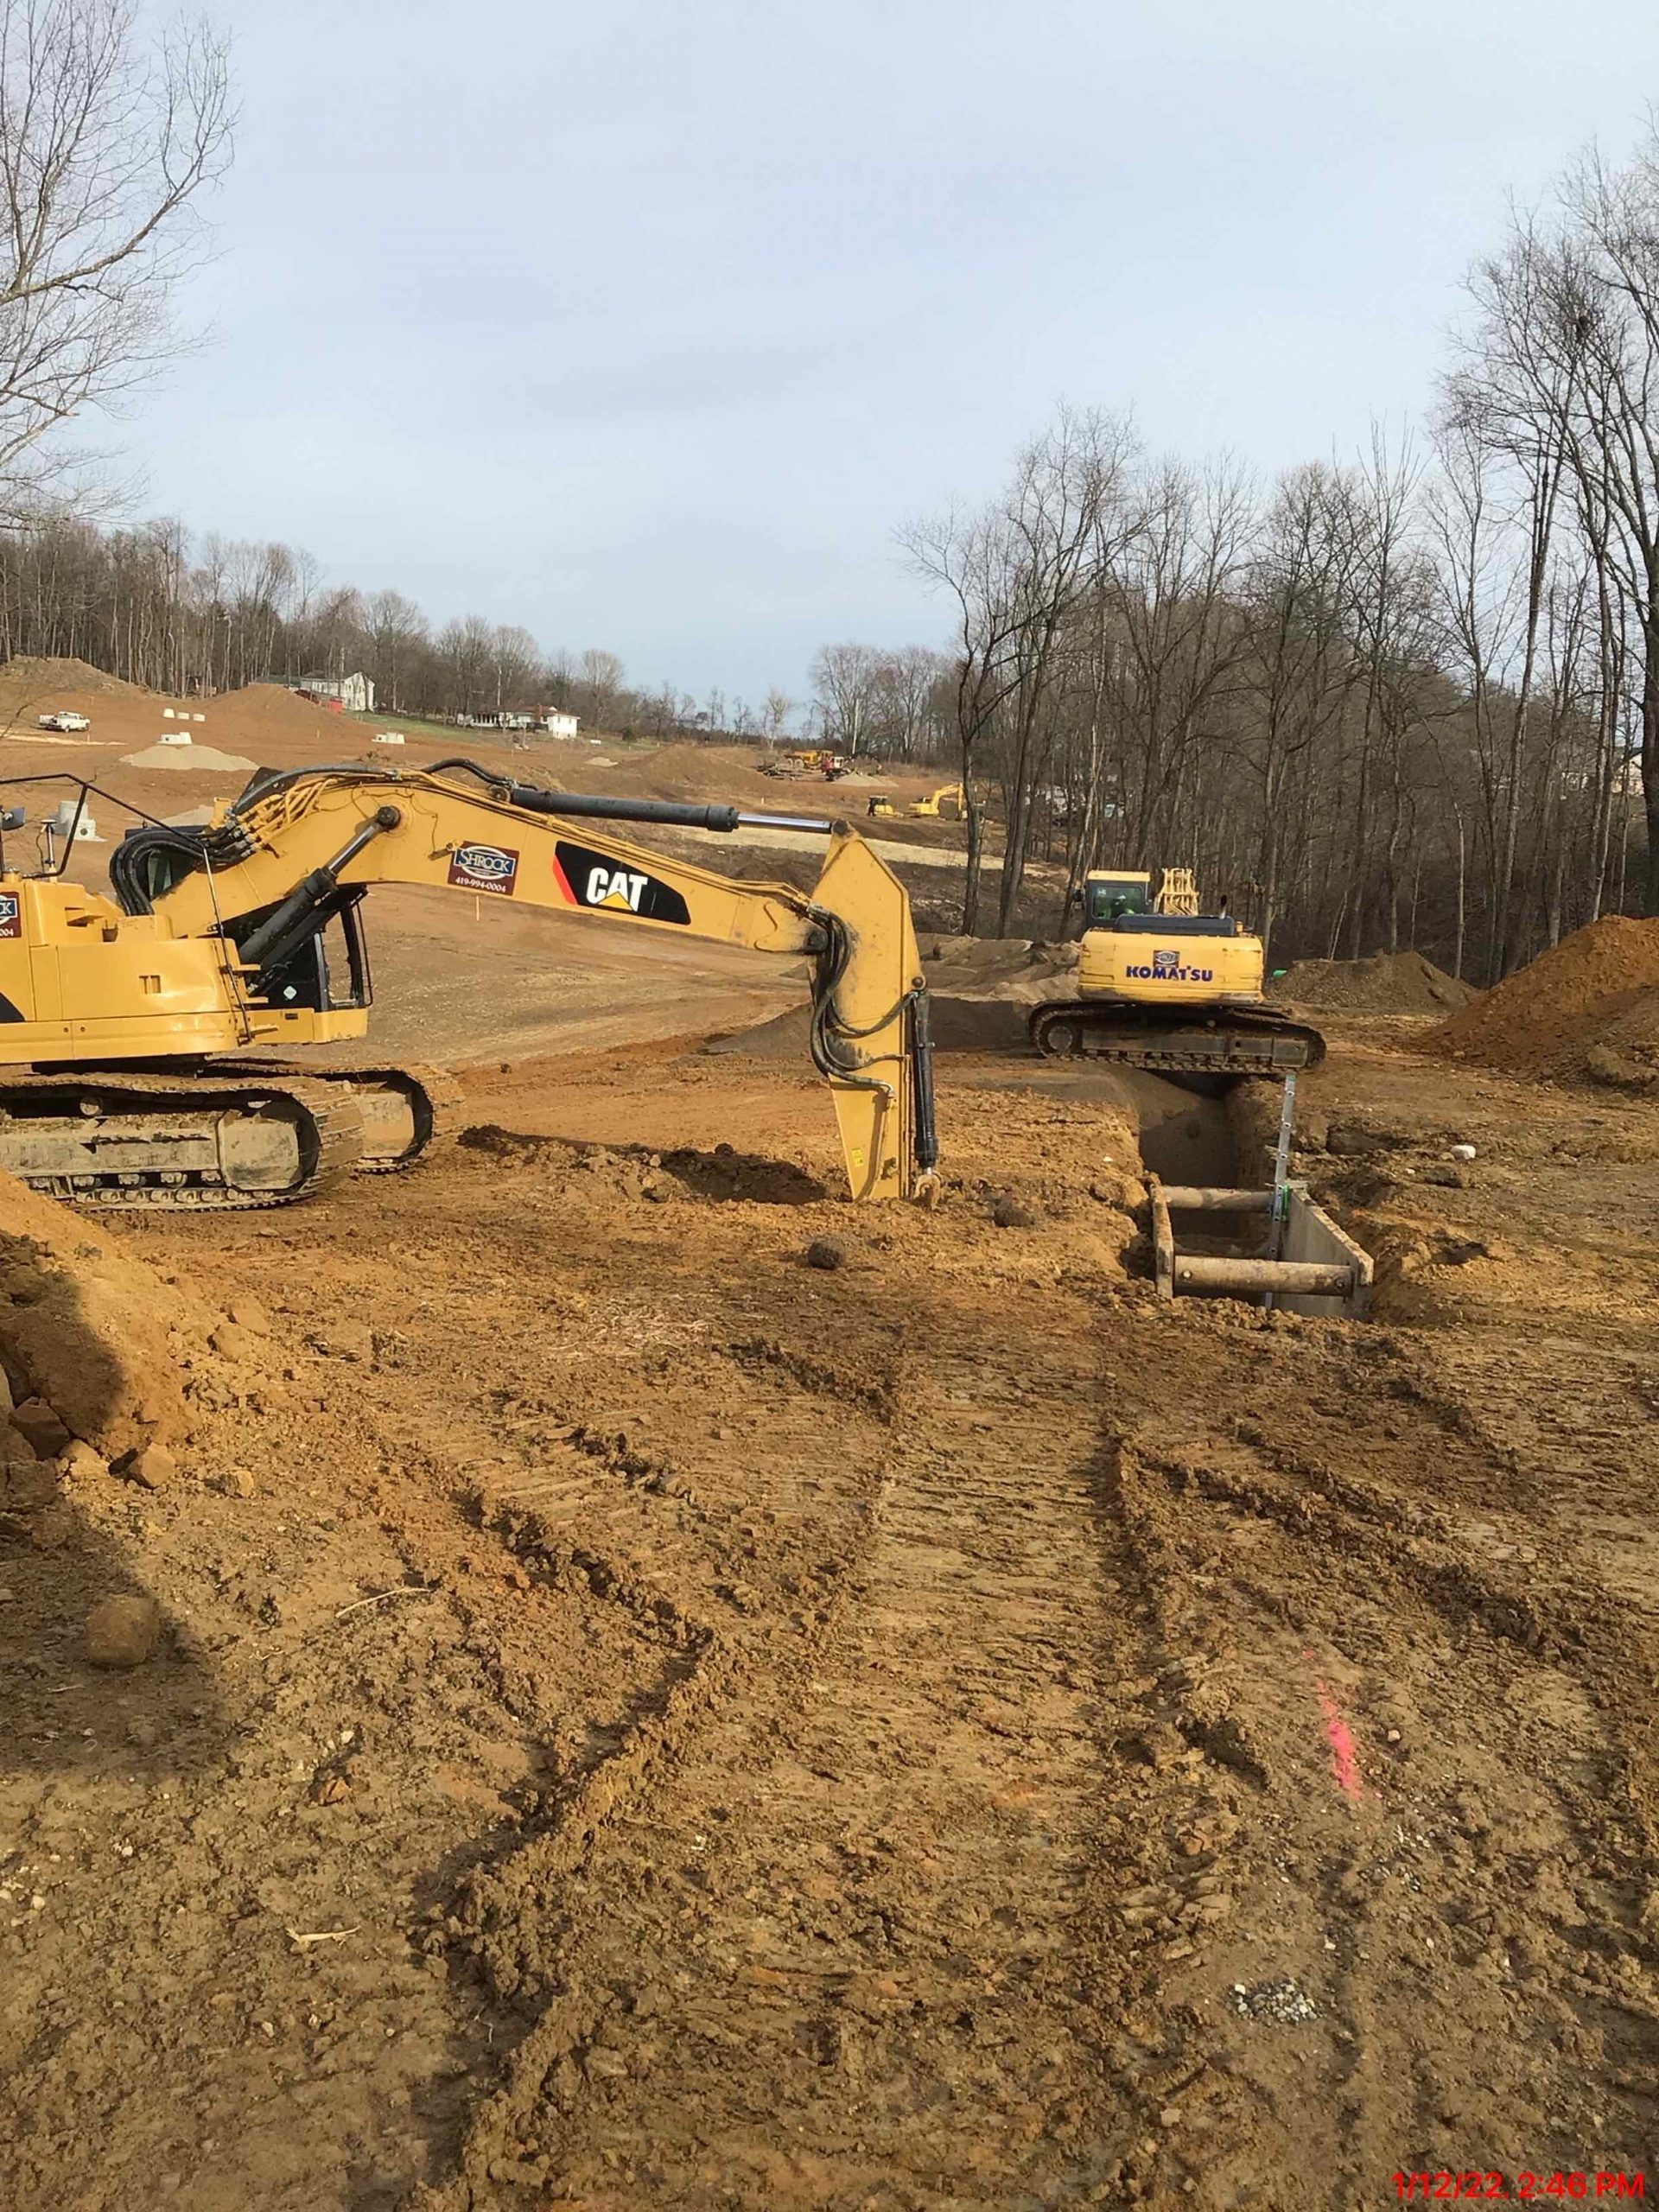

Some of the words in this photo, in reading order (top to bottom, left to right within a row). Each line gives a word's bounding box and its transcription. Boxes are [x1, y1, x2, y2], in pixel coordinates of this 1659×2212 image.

[458, 850, 510, 872] SHROCK
[455, 876, 506, 893] 419-994-0004
[586, 867, 648, 912] CAT
[1126, 965, 1212, 982] KOMATSU
